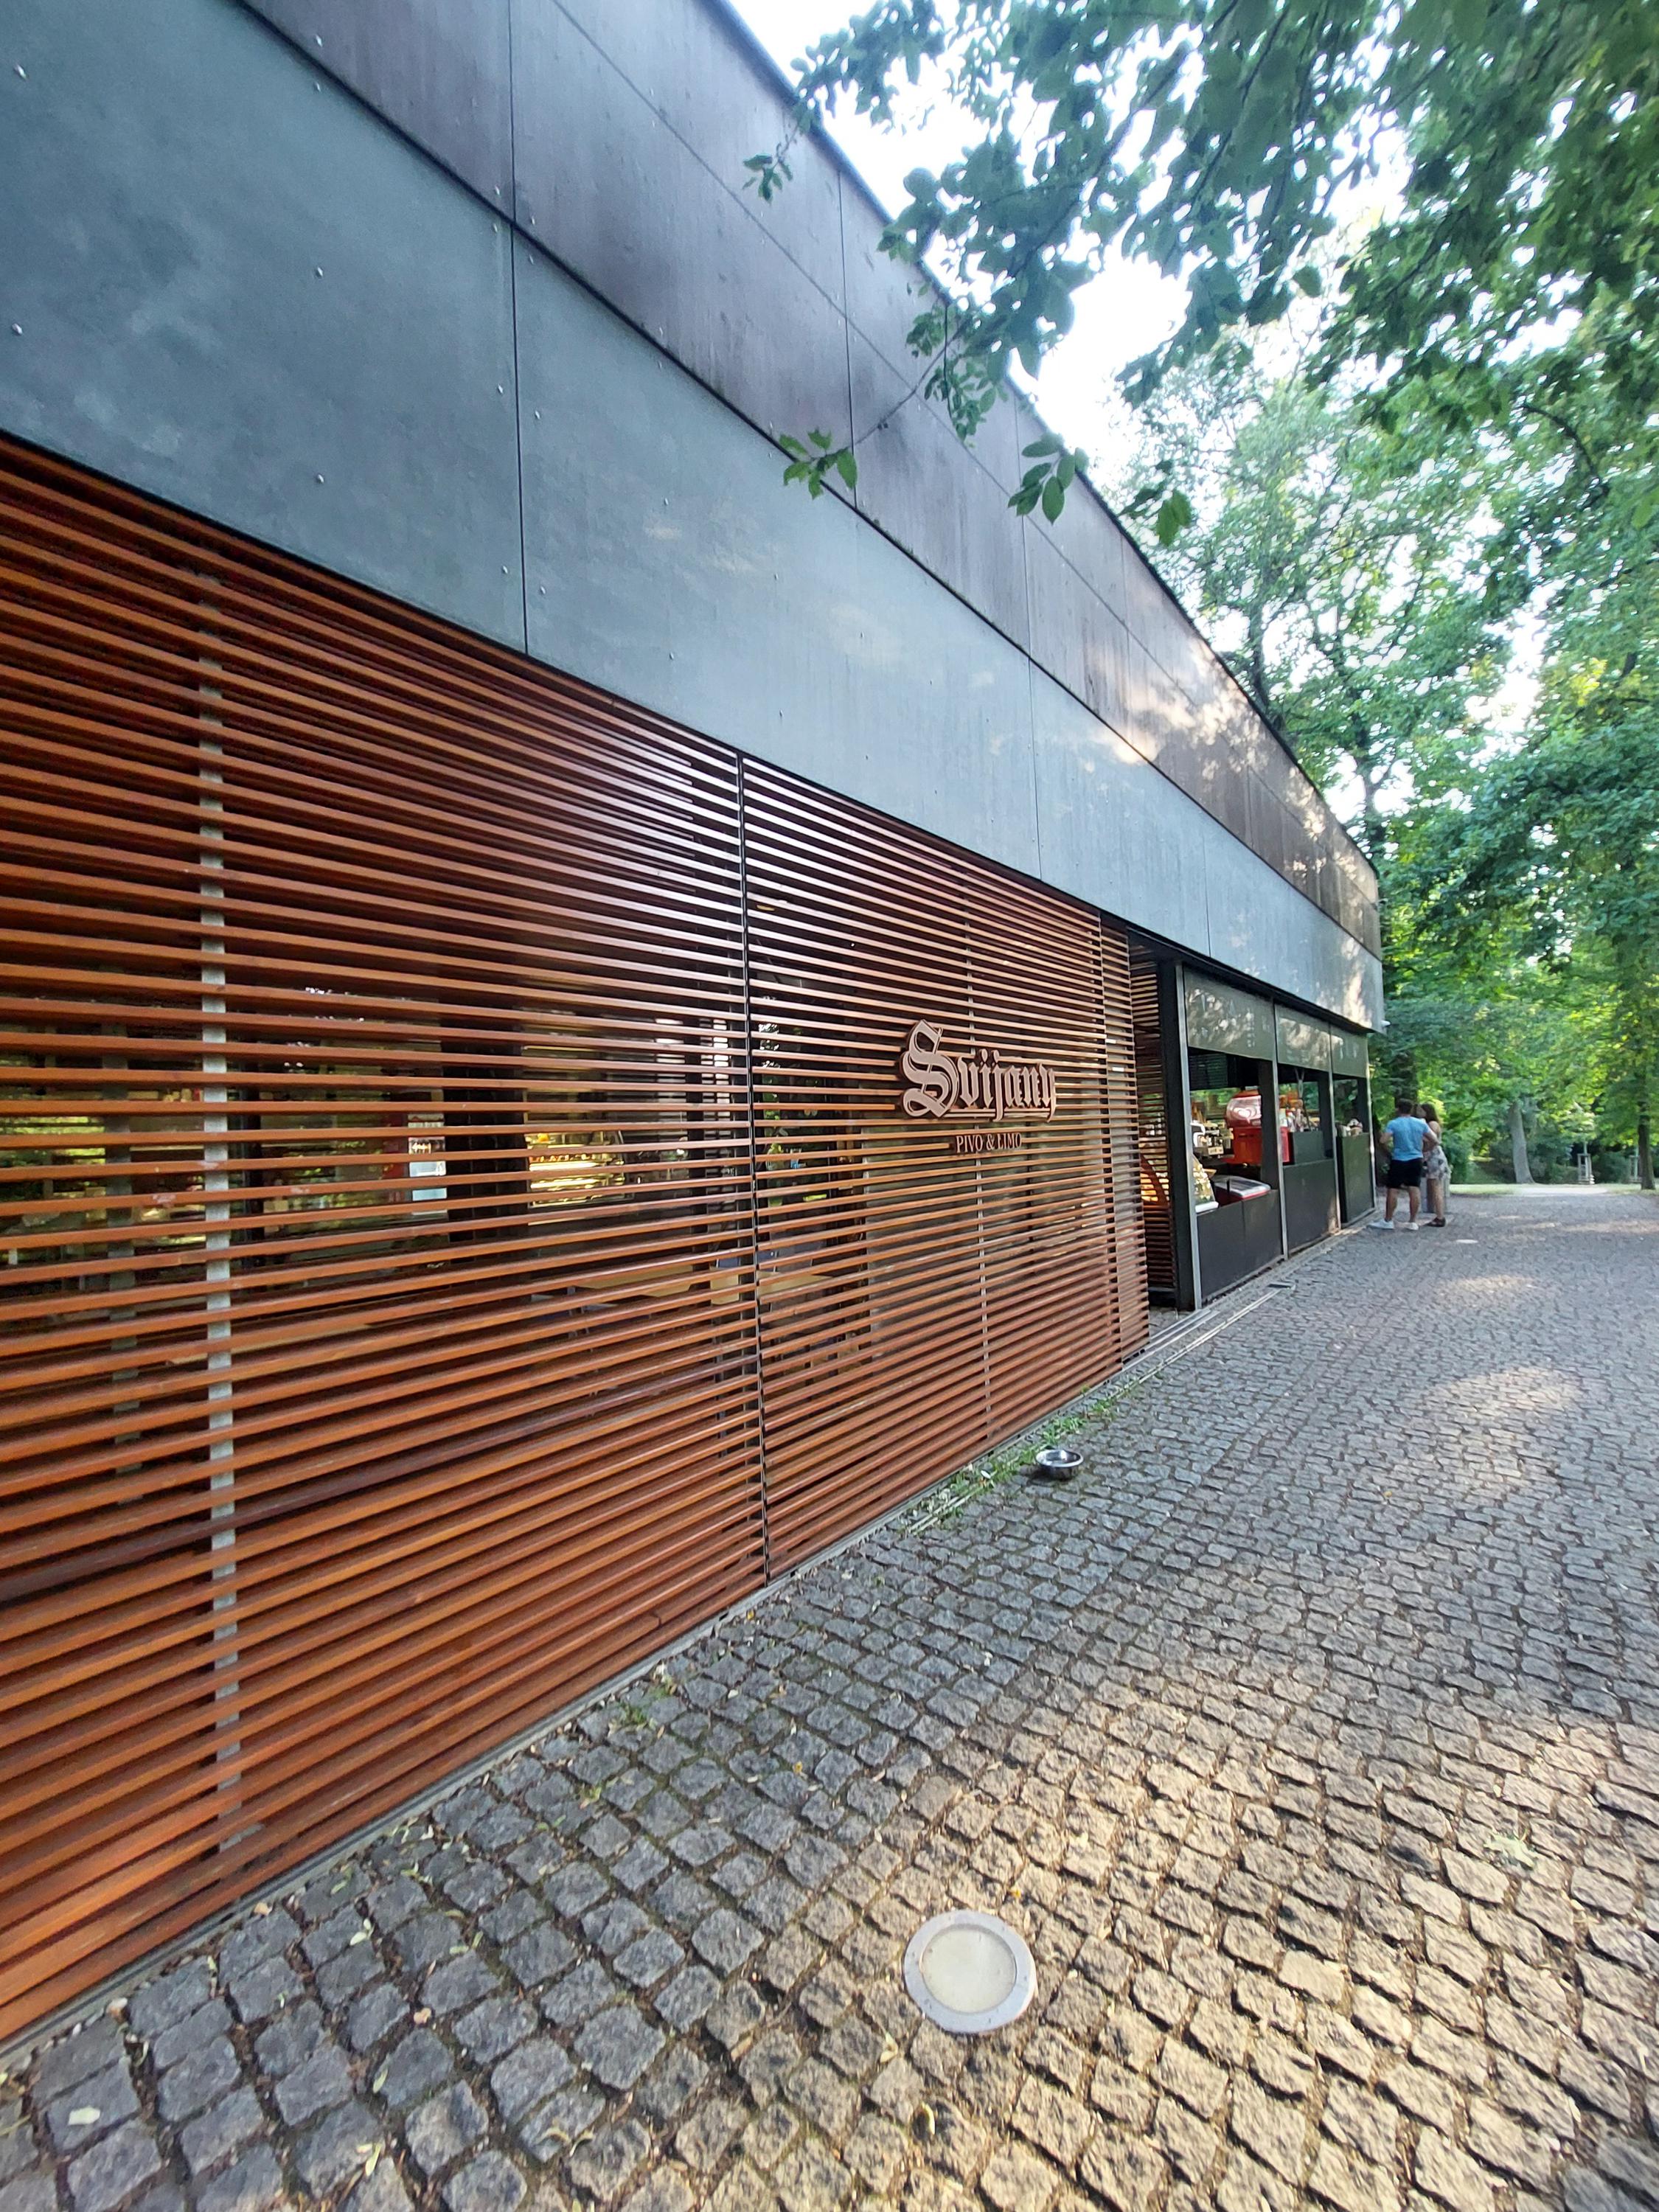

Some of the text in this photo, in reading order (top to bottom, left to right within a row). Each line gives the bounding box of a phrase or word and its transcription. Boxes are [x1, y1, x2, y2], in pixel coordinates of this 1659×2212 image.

[902, 1019, 1056, 1122] Svijany
[956, 1132, 1022, 1153] PIVO & LIMO
